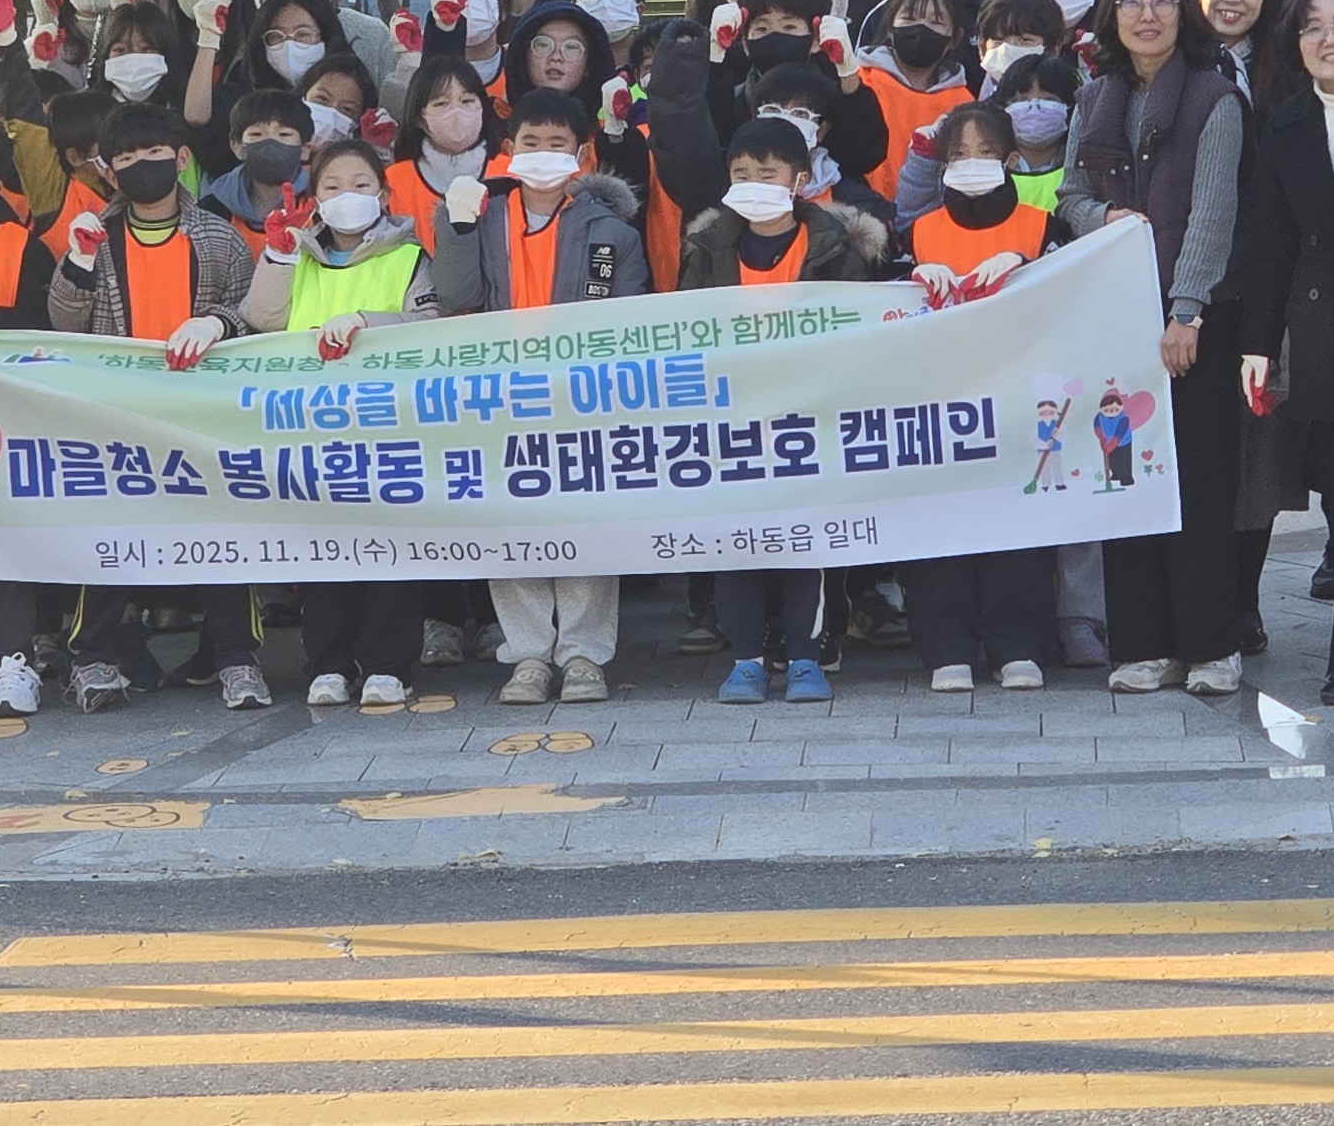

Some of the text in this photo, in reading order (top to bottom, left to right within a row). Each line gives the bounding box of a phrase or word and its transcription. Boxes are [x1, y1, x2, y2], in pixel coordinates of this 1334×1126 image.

[417, 371, 552, 423] 바꾸는
[569, 353, 730, 414] 아이들」
[7, 397, 997, 505] 마을청소 봉사활동 및 생태환경보호 캠페인
[95, 539, 147, 568] 일시
[173, 541, 249, 566] 2025.
[258, 539, 300, 564] 11.
[408, 540, 577, 563] 16:00~17:00
[651, 532, 707, 560] 장소
[731, 523, 814, 556] 하동읍
[823, 516, 880, 549] 일대
